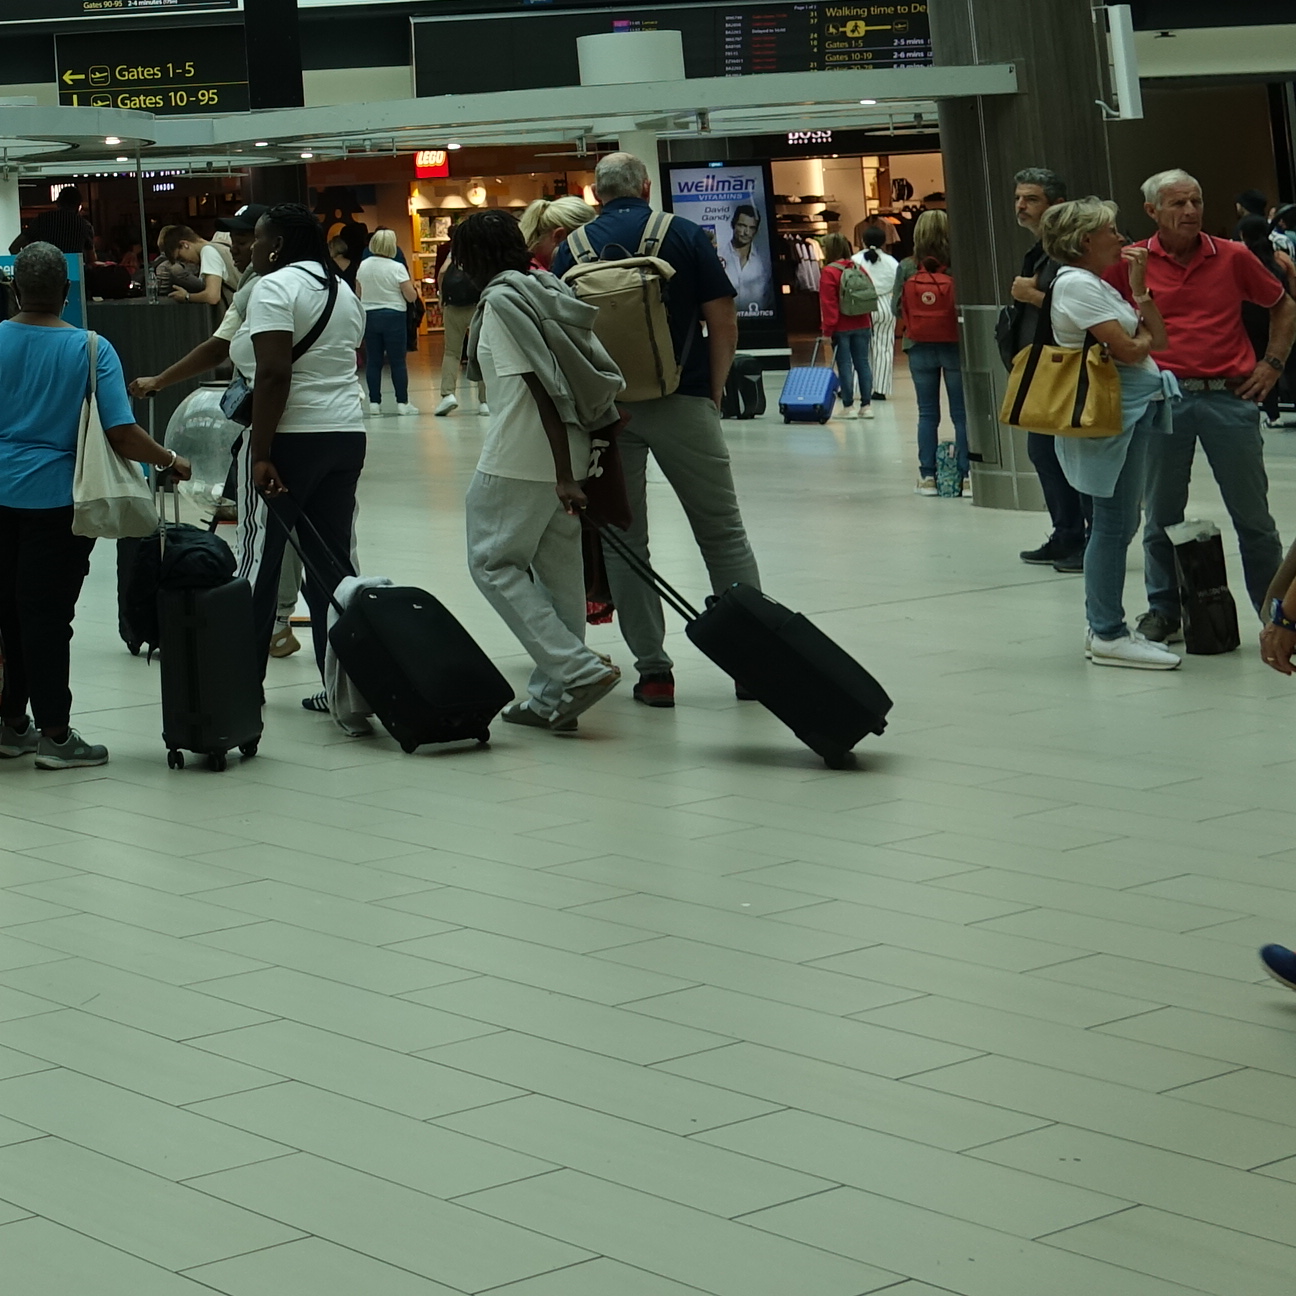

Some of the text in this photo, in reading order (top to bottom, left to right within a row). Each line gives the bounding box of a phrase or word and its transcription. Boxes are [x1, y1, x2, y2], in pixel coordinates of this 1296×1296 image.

[83, 1, 102, 9] Gates
[103, 0, 123, 8] 90-95
[127, 0, 137, 7] 2-4
[825, 3, 928, 18] Walking time to De
[825, 37, 924, 49] Gates 1-5 2-5 mins
[825, 53, 849, 61] Gates
[851, 51, 873, 60] 10-19
[906, 50, 924, 58] mins
[115, 65, 161, 80] Gates
[117, 93, 164, 109] Gates
[416, 150, 448, 168] LEGO
[677, 175, 756, 194] wellman
[698, 193, 743, 201] VITAMINS
[701, 214, 731, 222] Gandy
